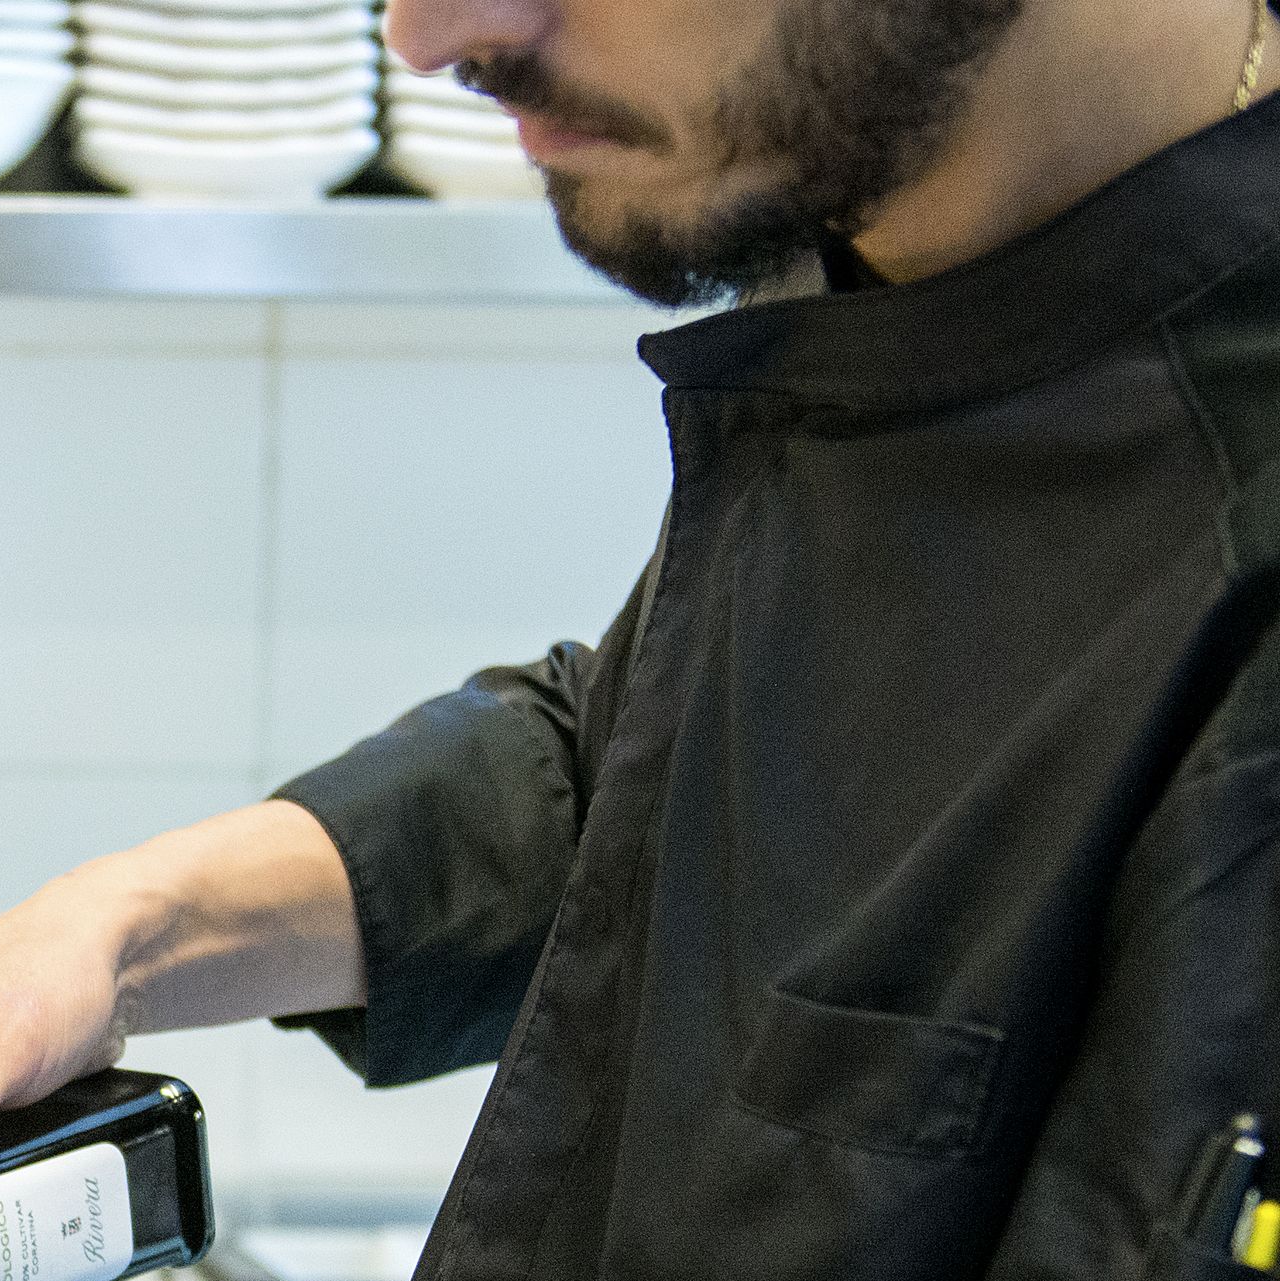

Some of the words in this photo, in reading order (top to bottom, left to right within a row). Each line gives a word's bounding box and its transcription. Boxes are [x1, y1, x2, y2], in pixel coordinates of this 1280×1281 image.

[15, 1200, 29, 1260] CULTIVAR
[28, 1210, 38, 1275] CORATINA
[82, 1177, 106, 1264] Rivera
